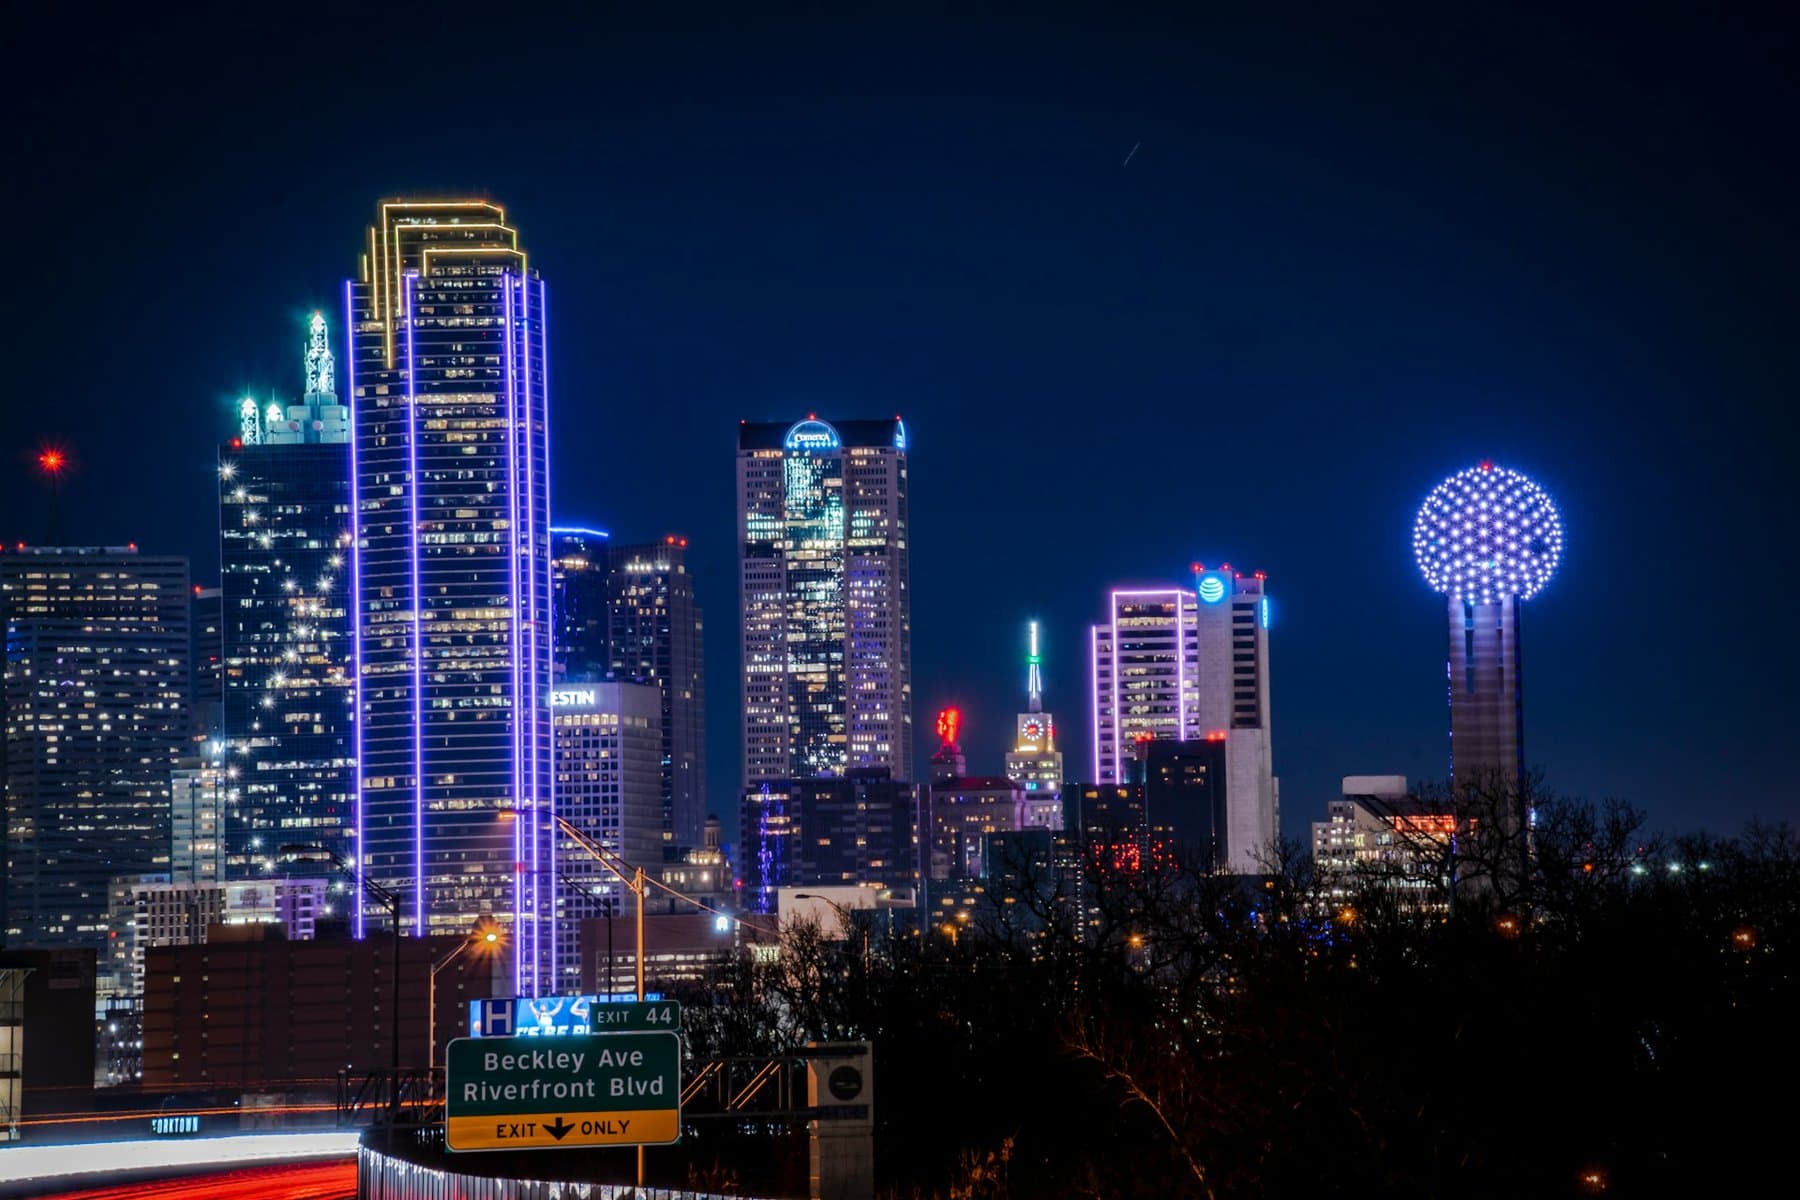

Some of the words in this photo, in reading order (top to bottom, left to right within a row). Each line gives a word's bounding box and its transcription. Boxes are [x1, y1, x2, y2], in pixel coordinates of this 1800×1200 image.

[551, 690, 595, 705] ESTIN
[485, 1001, 512, 1034] H
[597, 1010, 630, 1024] EXIT
[645, 1007, 672, 1024] 44
[484, 1049, 585, 1074] Beckley
[598, 1048, 644, 1068] Ave
[464, 1079, 595, 1102] Riverfront
[610, 1075, 664, 1097] Blvd
[496, 1123, 537, 1139] EXIT
[581, 1120, 631, 1136] ONLY
